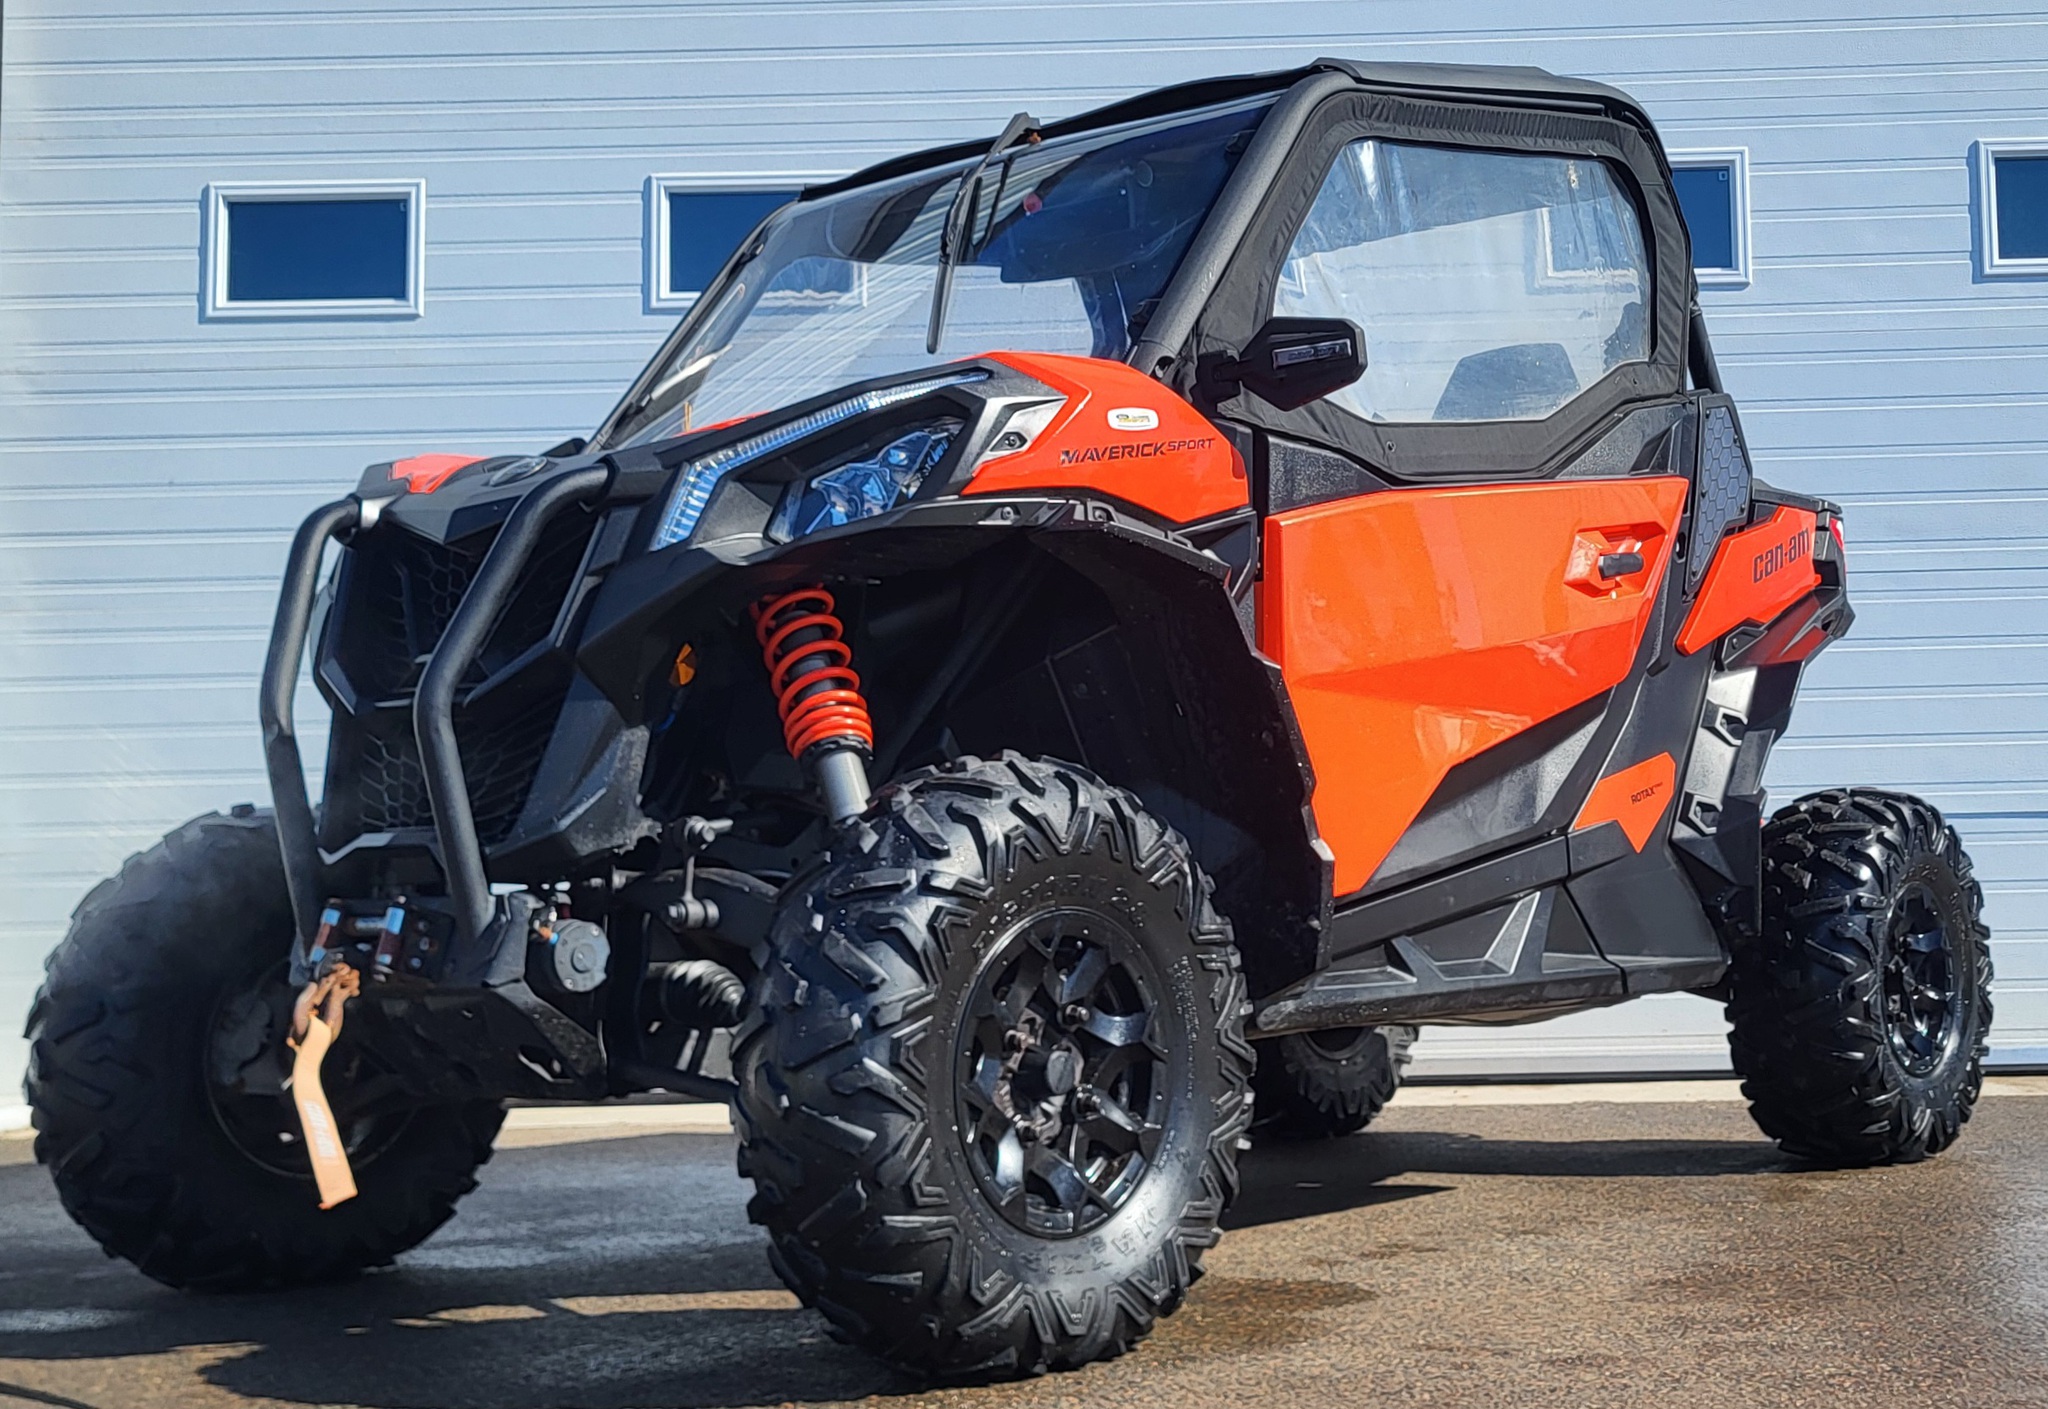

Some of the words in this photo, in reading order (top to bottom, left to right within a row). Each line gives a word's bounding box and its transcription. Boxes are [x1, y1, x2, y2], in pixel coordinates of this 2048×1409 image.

[1061, 443, 1166, 464] MAVERICK
[1167, 438, 1215, 452] SPORT
[1754, 528, 1810, 583] can-am
[1631, 786, 1655, 804] ROTAX
